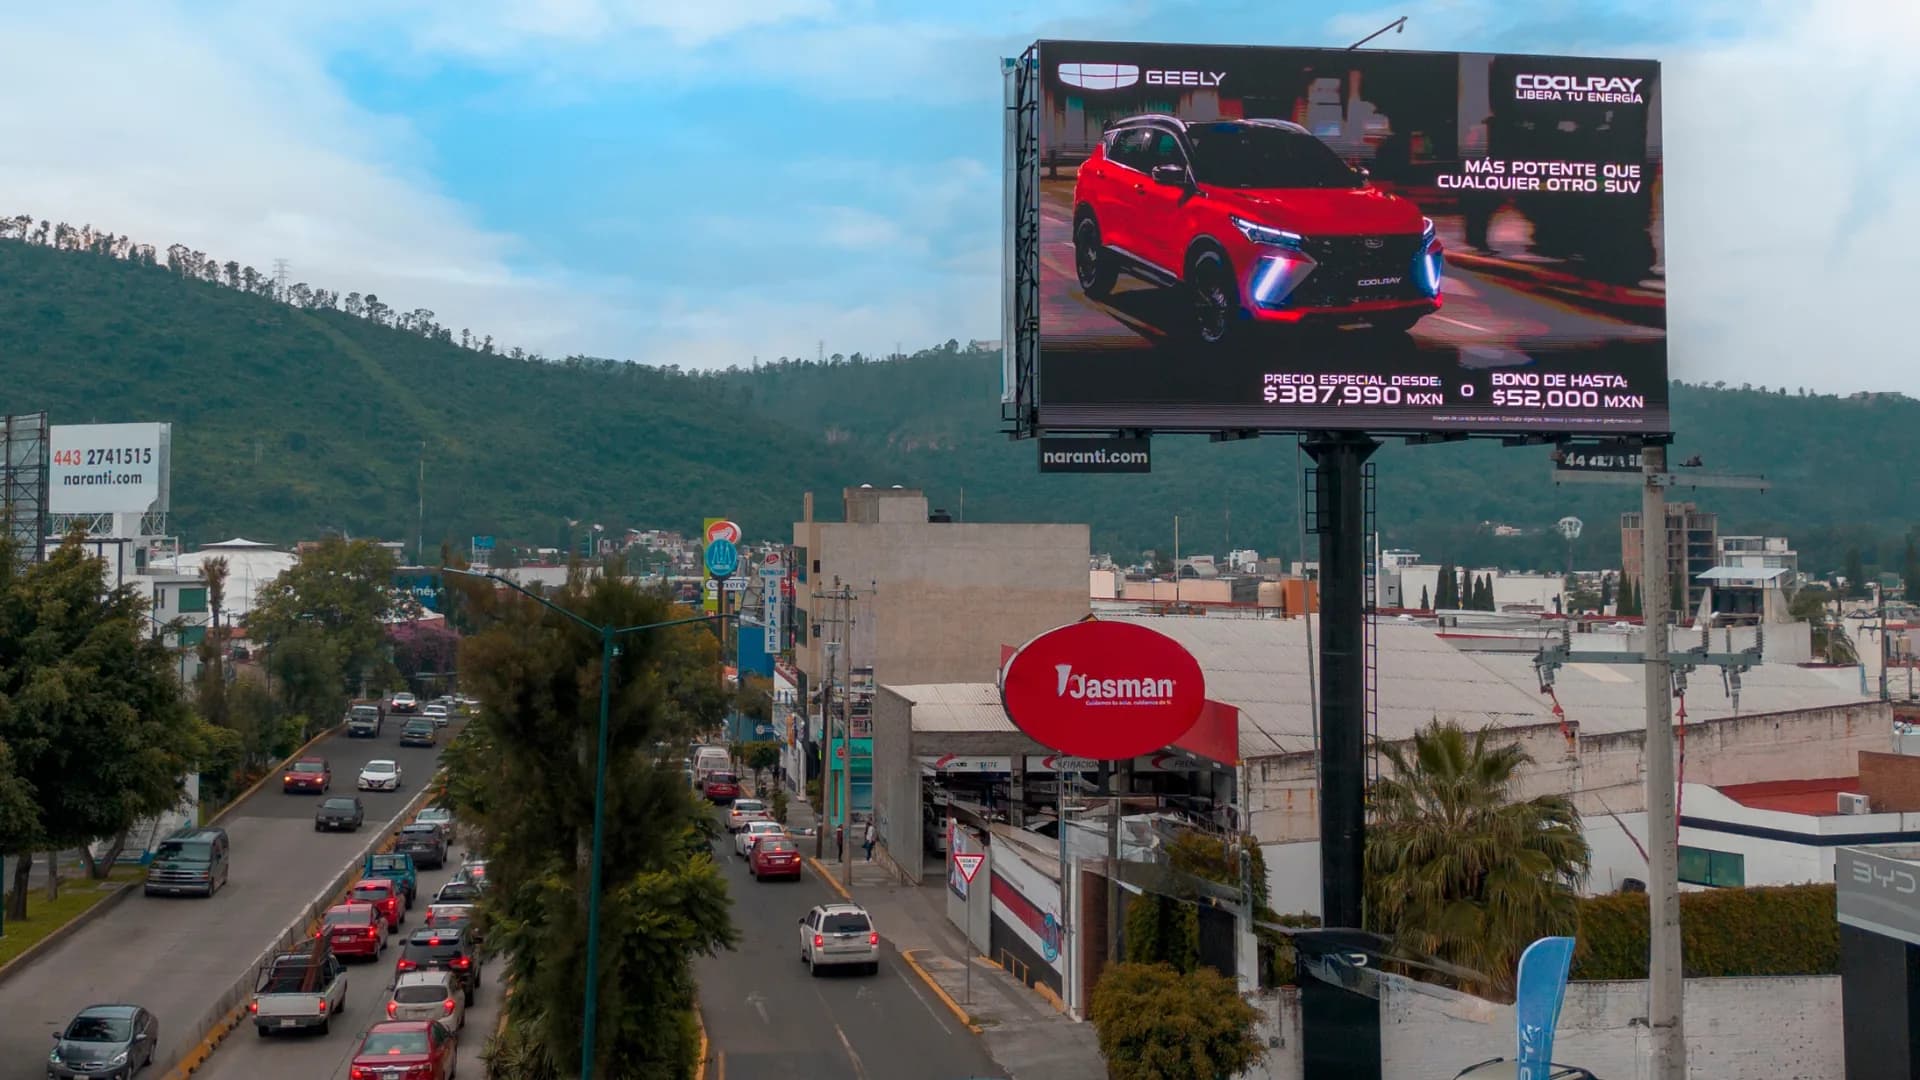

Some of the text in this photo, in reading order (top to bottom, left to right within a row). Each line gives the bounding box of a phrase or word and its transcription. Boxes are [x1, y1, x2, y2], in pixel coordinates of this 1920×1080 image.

[1146, 70, 1226, 86] GEELY
[1515, 74, 1643, 92] COOLRAY
[1515, 90, 1562, 100] LIBERA
[1567, 91, 1583, 101] TU
[1465, 157, 1641, 178] MÁS POTENTE QUE
[1437, 175, 1641, 193] CUALQUIER OTRO SUV
[1358, 276, 1402, 286] COOLRAY
[1264, 374, 1442, 386] PRECIO ESPECIAL DESDE:
[1492, 373, 1628, 388] BONO DE HASTA:
[1264, 385, 1443, 406] $387,990 MXN
[1492, 389, 1643, 409] $52,000 MXN
[54, 447, 152, 466] 443 2741515
[1043, 448, 1148, 464] naranti.com
[64, 470, 142, 485] naranti.com
[768, 580, 778, 651] SIMILARES
[1069, 673, 1173, 698] Jasman
[1852, 860, 1916, 894] BYD
